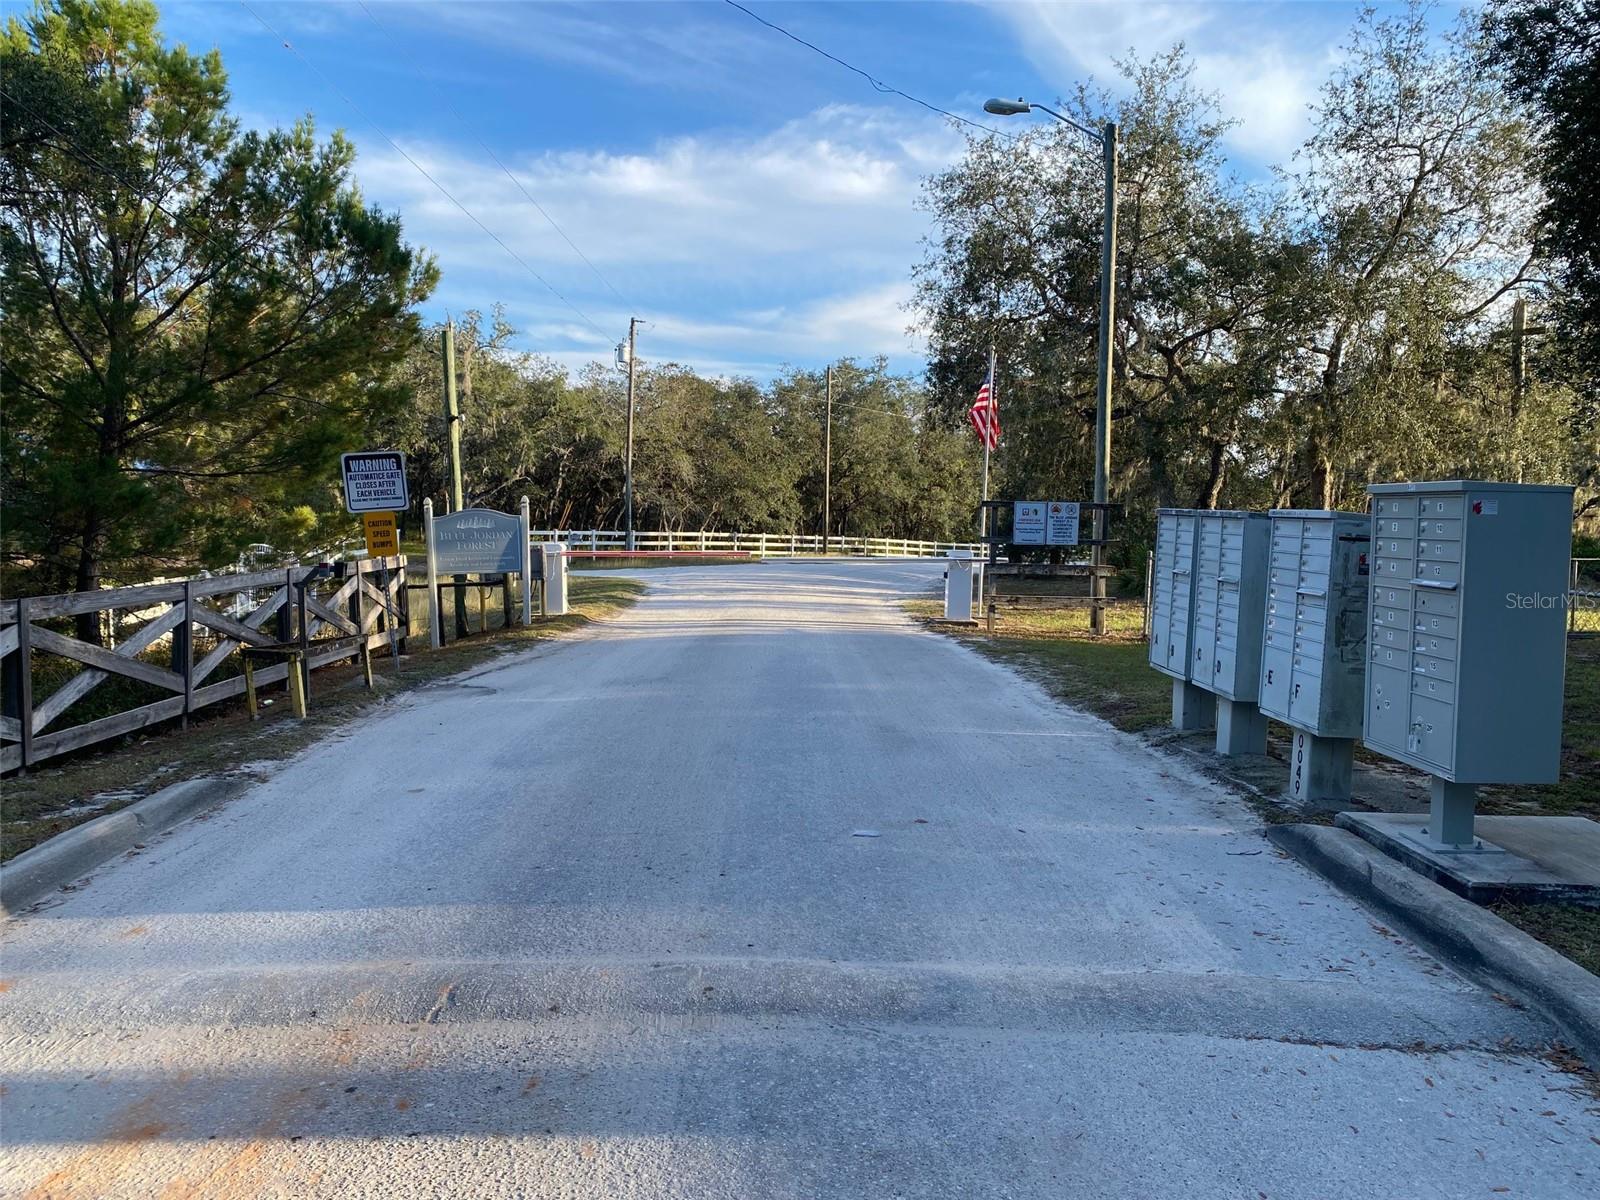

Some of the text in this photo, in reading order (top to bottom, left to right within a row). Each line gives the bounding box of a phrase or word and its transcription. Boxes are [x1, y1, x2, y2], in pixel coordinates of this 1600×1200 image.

[349, 458, 397, 472] WARNING
[386, 471, 400, 480] GATE
[356, 480, 396, 490] CLOSES AFTER
[356, 488, 396, 498] EACH VEHICLE
[368, 520, 392, 528] CAUTION
[440, 530, 514, 540] BLUE JORDAN
[372, 540, 392, 548] BUMPS
[457, 541, 496, 550] FOREST
[1155, 633, 1159, 644] A
[1198, 648, 1202, 660] C
[1216, 660, 1221, 673] D
[1268, 670, 1273, 684] E
[1295, 684, 1300, 699] F
[1295, 734, 1304, 795] 0049
